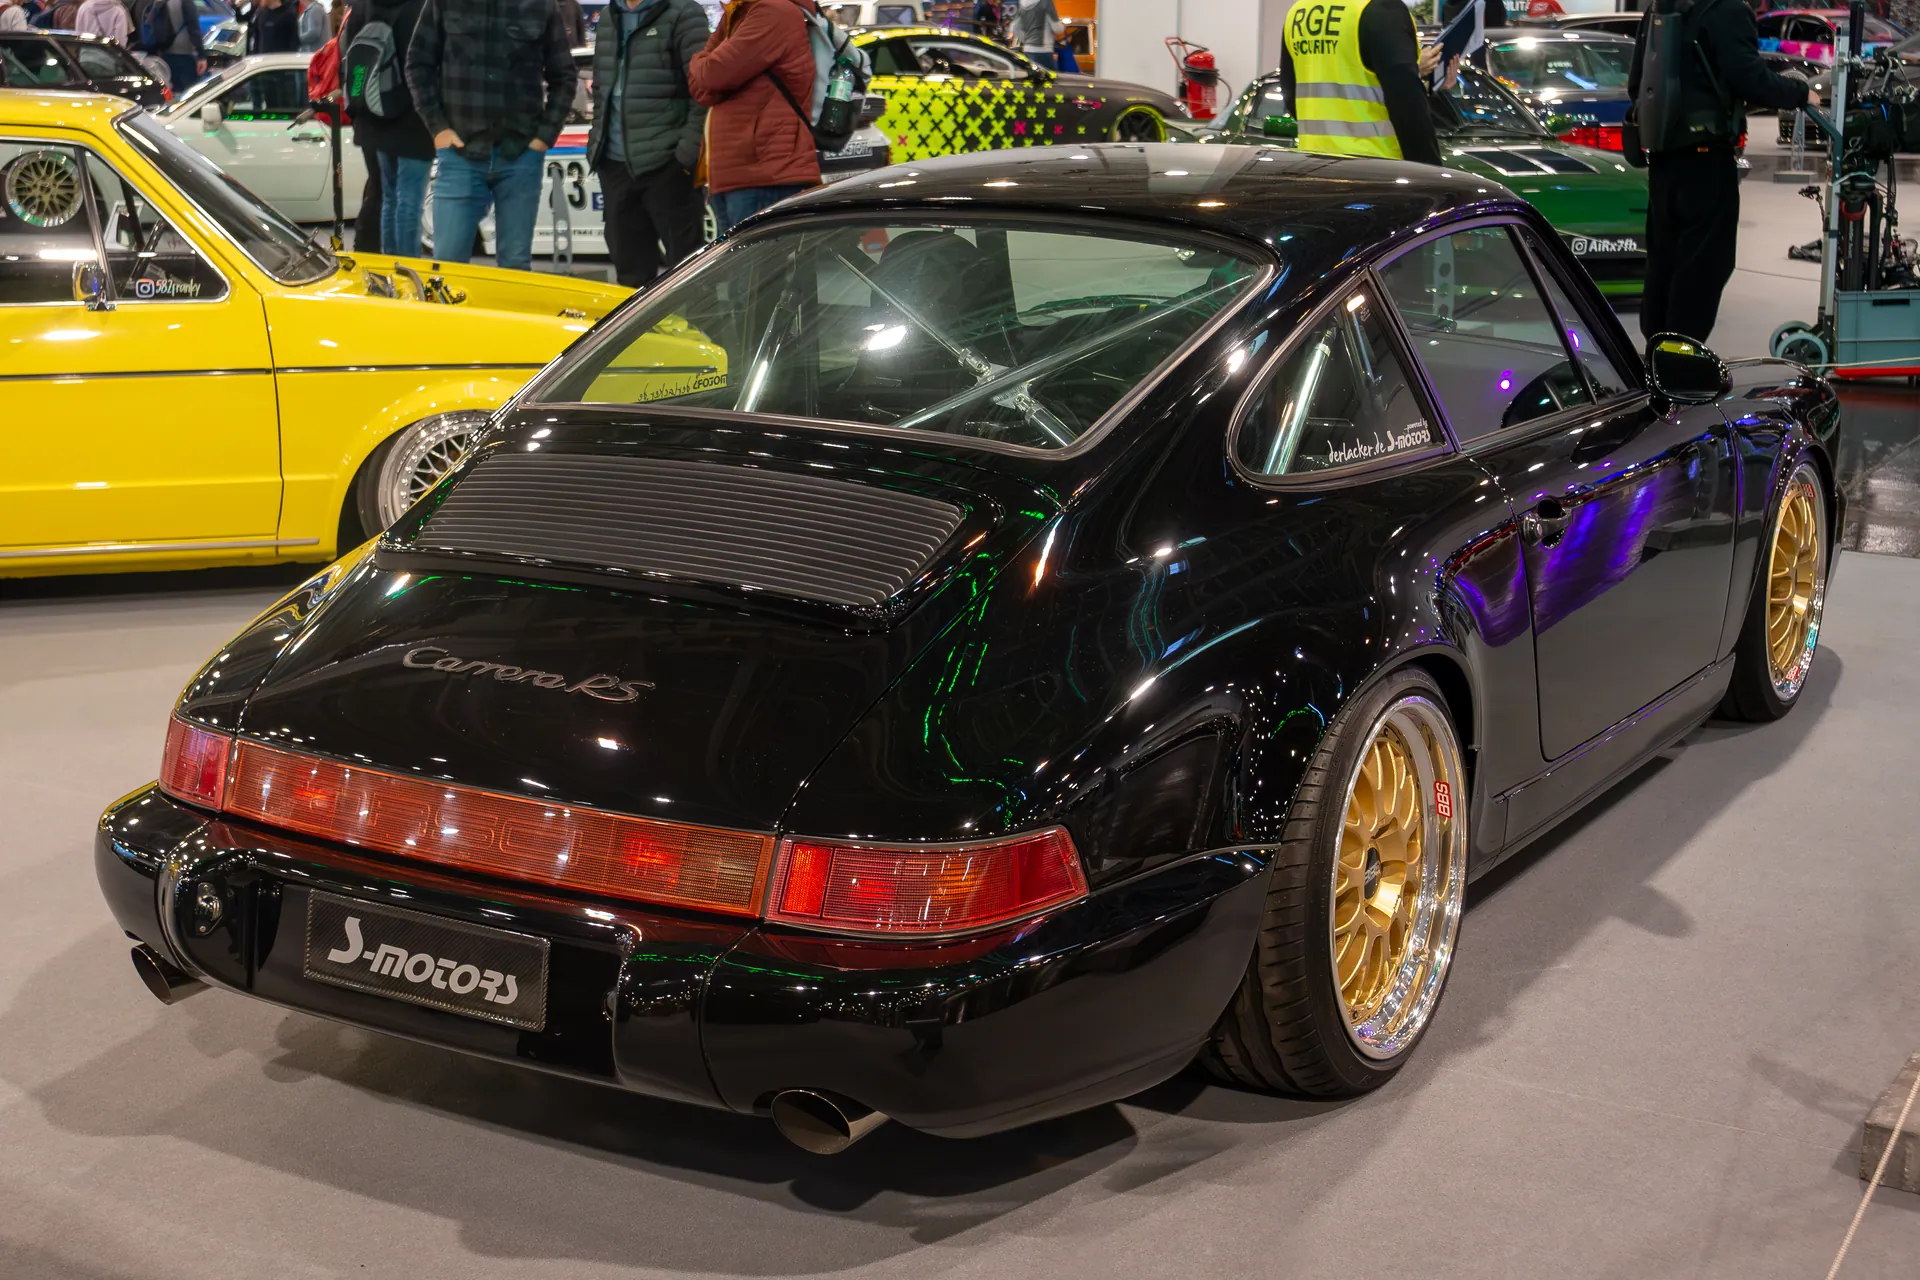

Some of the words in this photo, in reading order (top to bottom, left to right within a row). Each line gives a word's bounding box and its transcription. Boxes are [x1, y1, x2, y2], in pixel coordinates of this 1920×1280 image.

[1291, 5, 1346, 39] RGE
[1327, 432, 1386, 463] derlacker.de
[402, 645, 566, 690] Carrera
[564, 673, 656, 703] RS
[1436, 782, 1450, 816] BBS
[327, 916, 519, 1005] S-MOTORS
